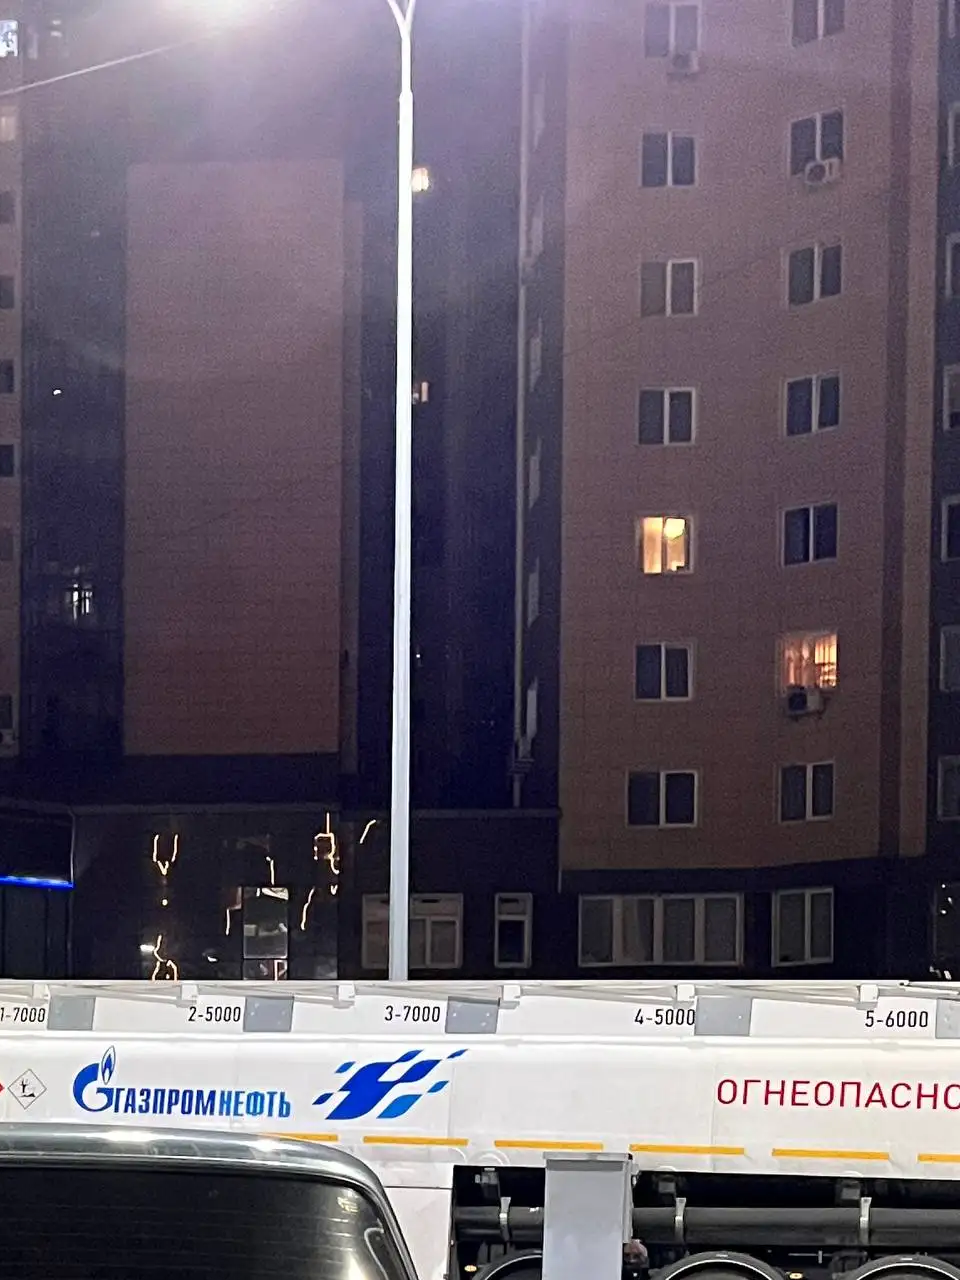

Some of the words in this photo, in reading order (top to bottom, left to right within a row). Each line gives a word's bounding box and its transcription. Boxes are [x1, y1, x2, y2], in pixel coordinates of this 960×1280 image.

[0, 1006, 46, 1024] 1-7000
[188, 1005, 241, 1023] 2-5000
[384, 1005, 441, 1023] 3-7000
[634, 1008, 696, 1026] 4-5000
[864, 1009, 929, 1028] 5-6000
[113, 1086, 291, 1119] ГАЗПРОМНЕФТЬ
